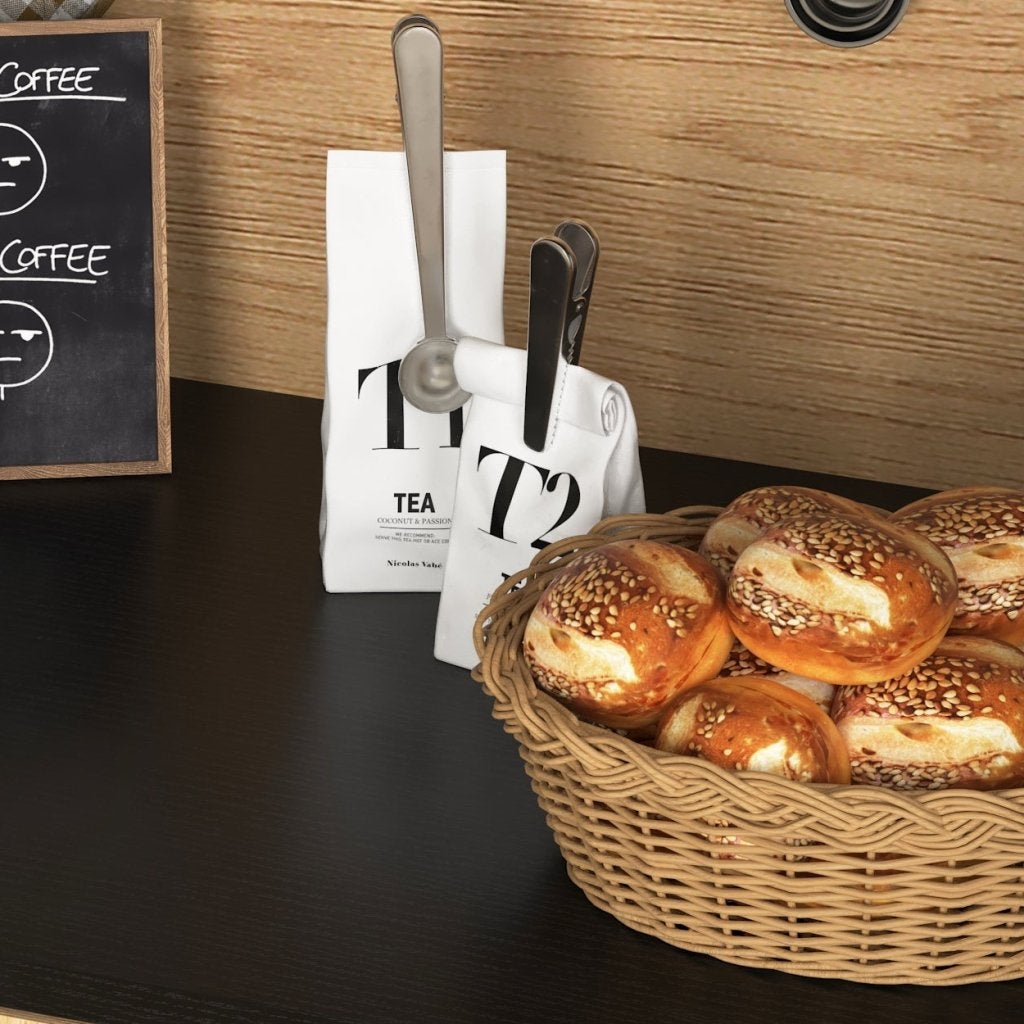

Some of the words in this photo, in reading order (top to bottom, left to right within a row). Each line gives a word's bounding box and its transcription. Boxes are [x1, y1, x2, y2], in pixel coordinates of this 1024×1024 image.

[394, 492, 435, 513] TEA
[477, 444, 581, 549] T2
[377, 517, 413, 525] COCONUT
[422, 517, 452, 525] PASSION
[387, 559, 420, 567] Nicolas
